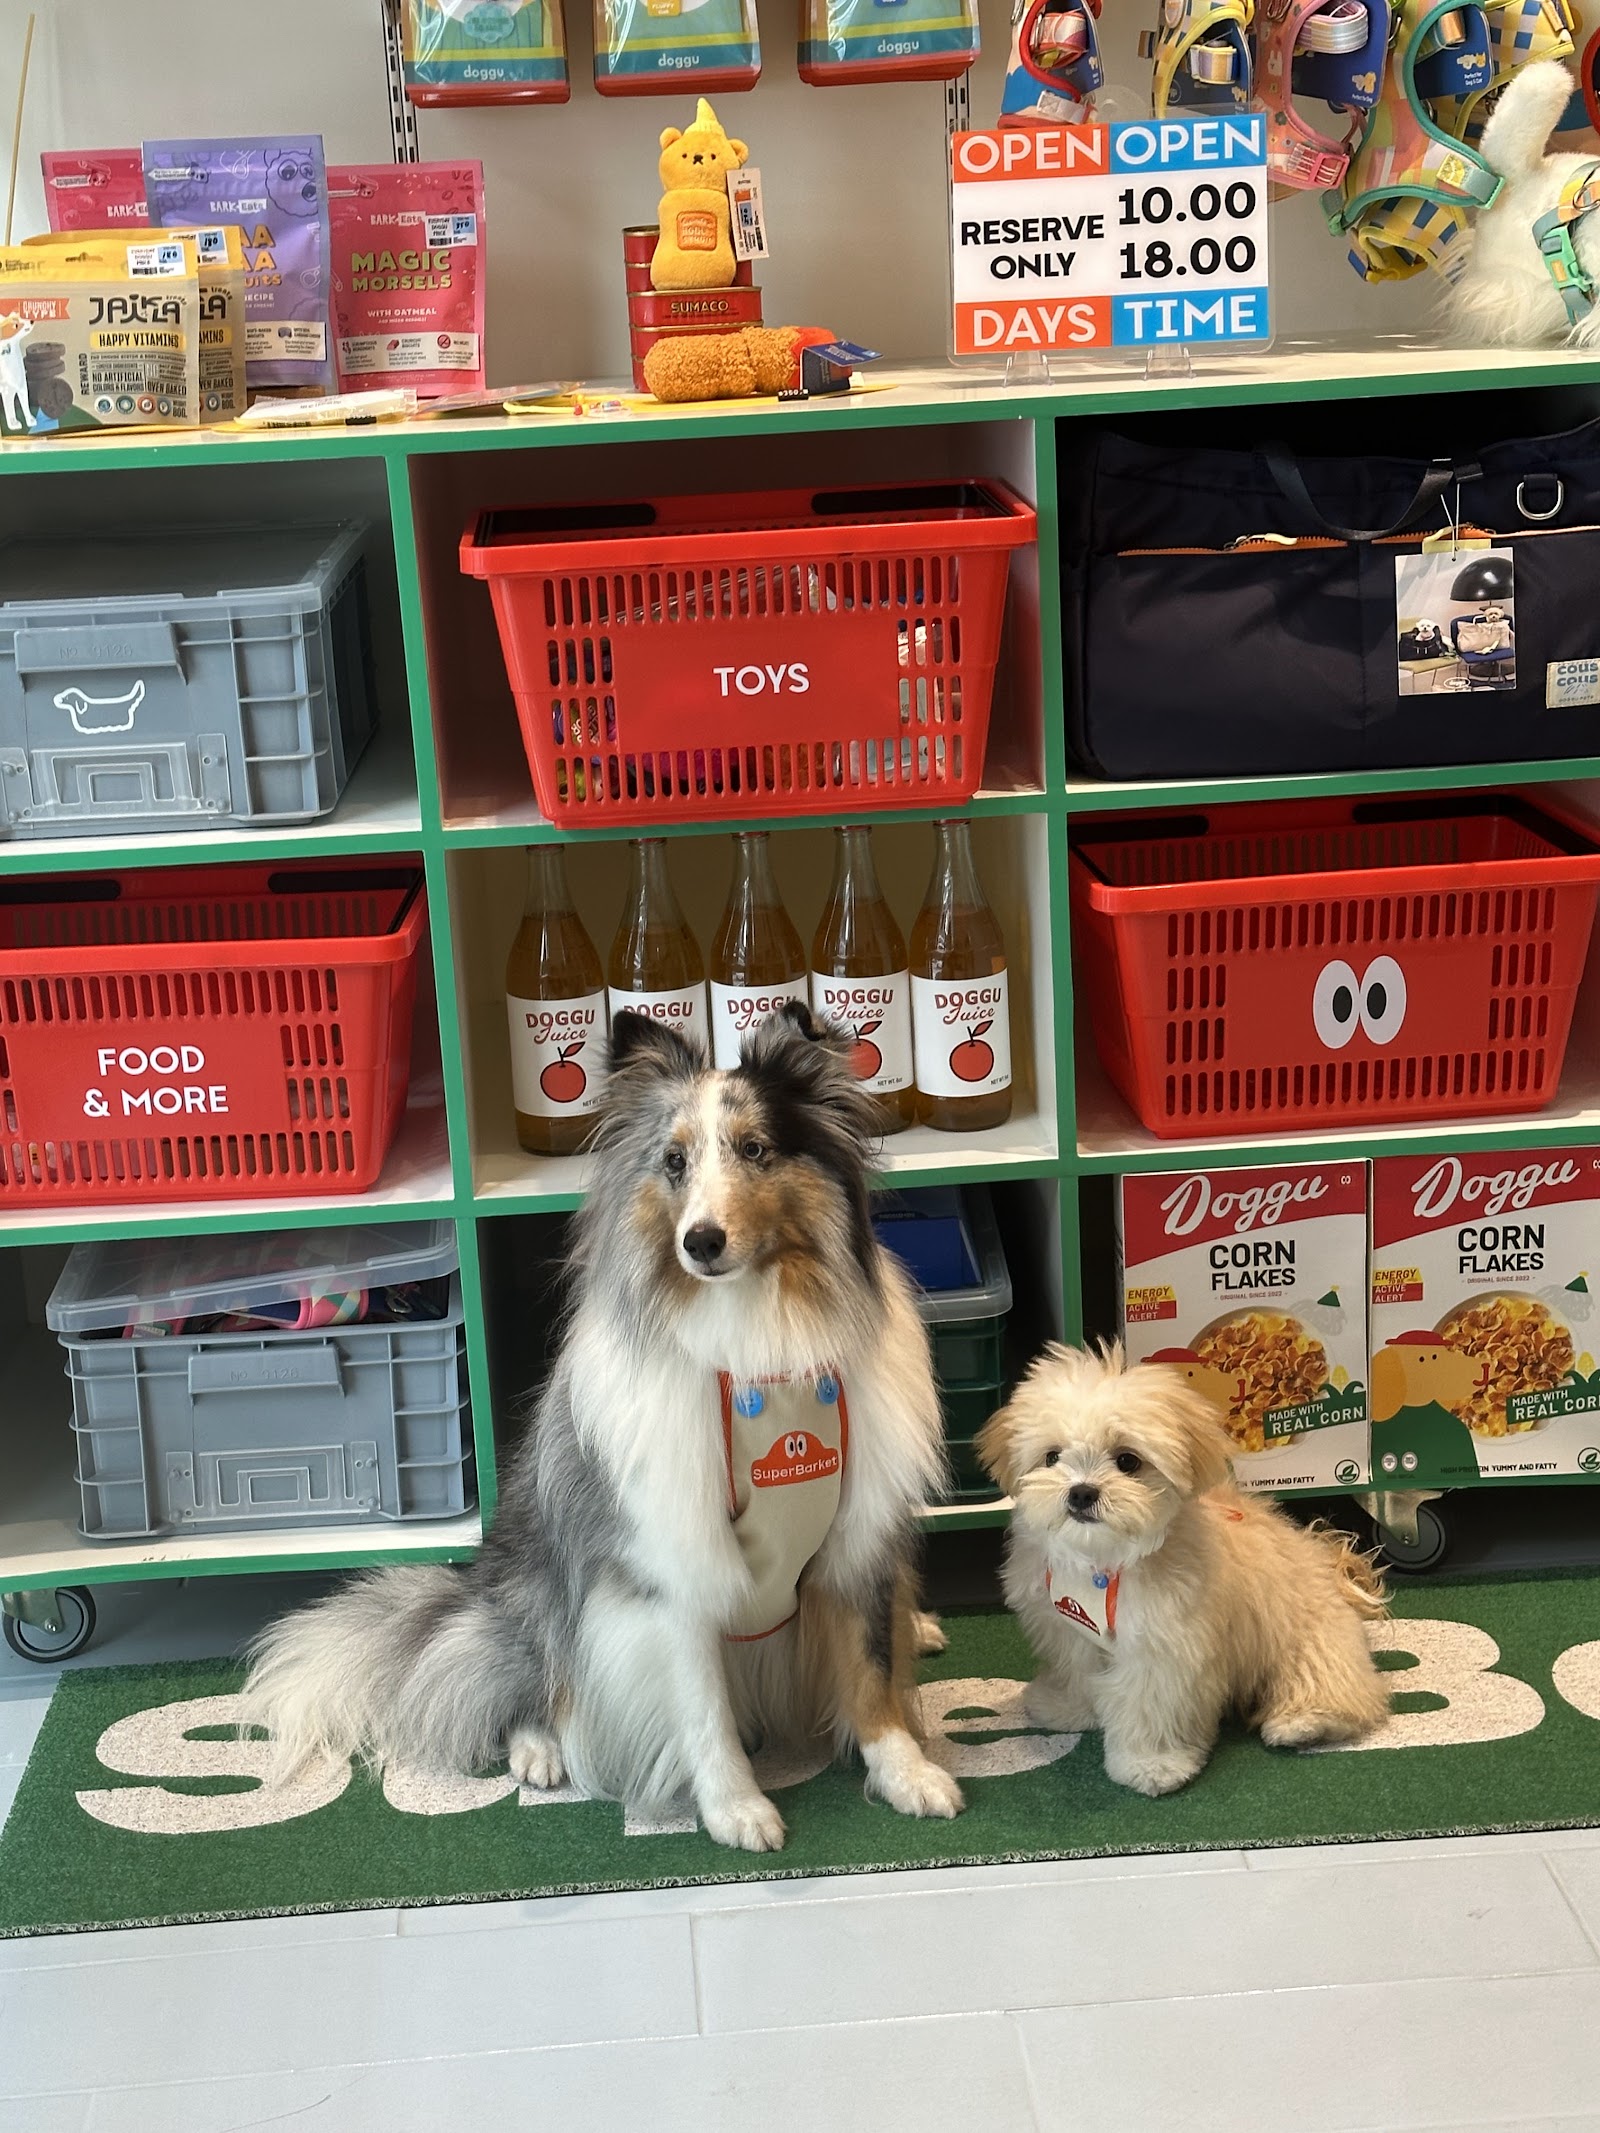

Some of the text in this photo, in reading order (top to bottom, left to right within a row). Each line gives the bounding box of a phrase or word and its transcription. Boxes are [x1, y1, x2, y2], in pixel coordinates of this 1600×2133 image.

[877, 39, 920, 55] doggu
[658, 53, 700, 69] doggu
[463, 64, 505, 81] doggu
[959, 129, 1102, 174] OPEN
[1115, 119, 1260, 165] OPEN
[107, 205, 135, 217] BARK
[210, 201, 239, 213] BARK
[1118, 181, 1256, 225] 10.00
[370, 214, 397, 226] BARK
[961, 214, 1104, 245] RESERVE
[351, 249, 452, 273] MAGIC
[990, 252, 1076, 280] ONLY
[1119, 235, 1256, 279] 18.00
[352, 273, 452, 292] MORSELS
[23, 310, 57, 319] TYPE
[367, 306, 437, 318] WITH OATMEAL
[669, 299, 730, 314] SUMACO
[973, 303, 1097, 347] DAYS
[1123, 294, 1257, 339] TIME
[99, 332, 180, 349] HAPPY VITAMINS
[78, 352, 90, 396] REWARD
[92, 371, 103, 383] NO
[104, 371, 144, 383] ARTIFICIAL
[213, 377, 234, 390] BAKED
[147, 380, 187, 396] OVEN BAKED
[713, 662, 810, 697] TOYS
[824, 988, 894, 1005] DOGGU
[934, 987, 1002, 1009] DOGGU
[525, 1009, 596, 1029] DOGGU
[831, 1003, 886, 1022] Juice
[942, 1005, 996, 1025] Juice
[533, 1026, 588, 1045] Juice
[98, 1045, 206, 1077] FOOD
[83, 1085, 230, 1118] & MORE
[1411, 1156, 1581, 1218] Doggu
[1160, 1174, 1329, 1236] Doggu
[1457, 1224, 1545, 1252] CORN
[1209, 1239, 1296, 1269] CORN
[1459, 1252, 1544, 1275] FLAKES
[1211, 1267, 1296, 1291] FLAKES
[1374, 1268, 1417, 1281] ENERGY
[1467, 1274, 1531, 1284] ORIGINAL SINCE 2022
[1127, 1286, 1171, 1300] ENERGY
[1220, 1290, 1283, 1301] ORIGINAL SINCE 2022
[1375, 1283, 1407, 1294] ACTIVE
[1375, 1293, 1404, 1303] ALERT
[1128, 1302, 1160, 1312] ACTIVE
[1128, 1311, 1158, 1322] ALERT
[1512, 1389, 1568, 1408] MADE WITH
[1515, 1395, 1600, 1420] REAL COR
[1268, 1402, 1324, 1422] MADE WITH
[1272, 1405, 1364, 1436] REAL CORN
[753, 1455, 838, 1481] SuperBarket
[1491, 1463, 1518, 1472] YUMMY
[1518, 1463, 1535, 1471] AND
[1535, 1462, 1558, 1470] FATTY
[1250, 1478, 1276, 1487] YUMMY
[1276, 1477, 1293, 1485] AND
[1293, 1475, 1316, 1484] FATTY
